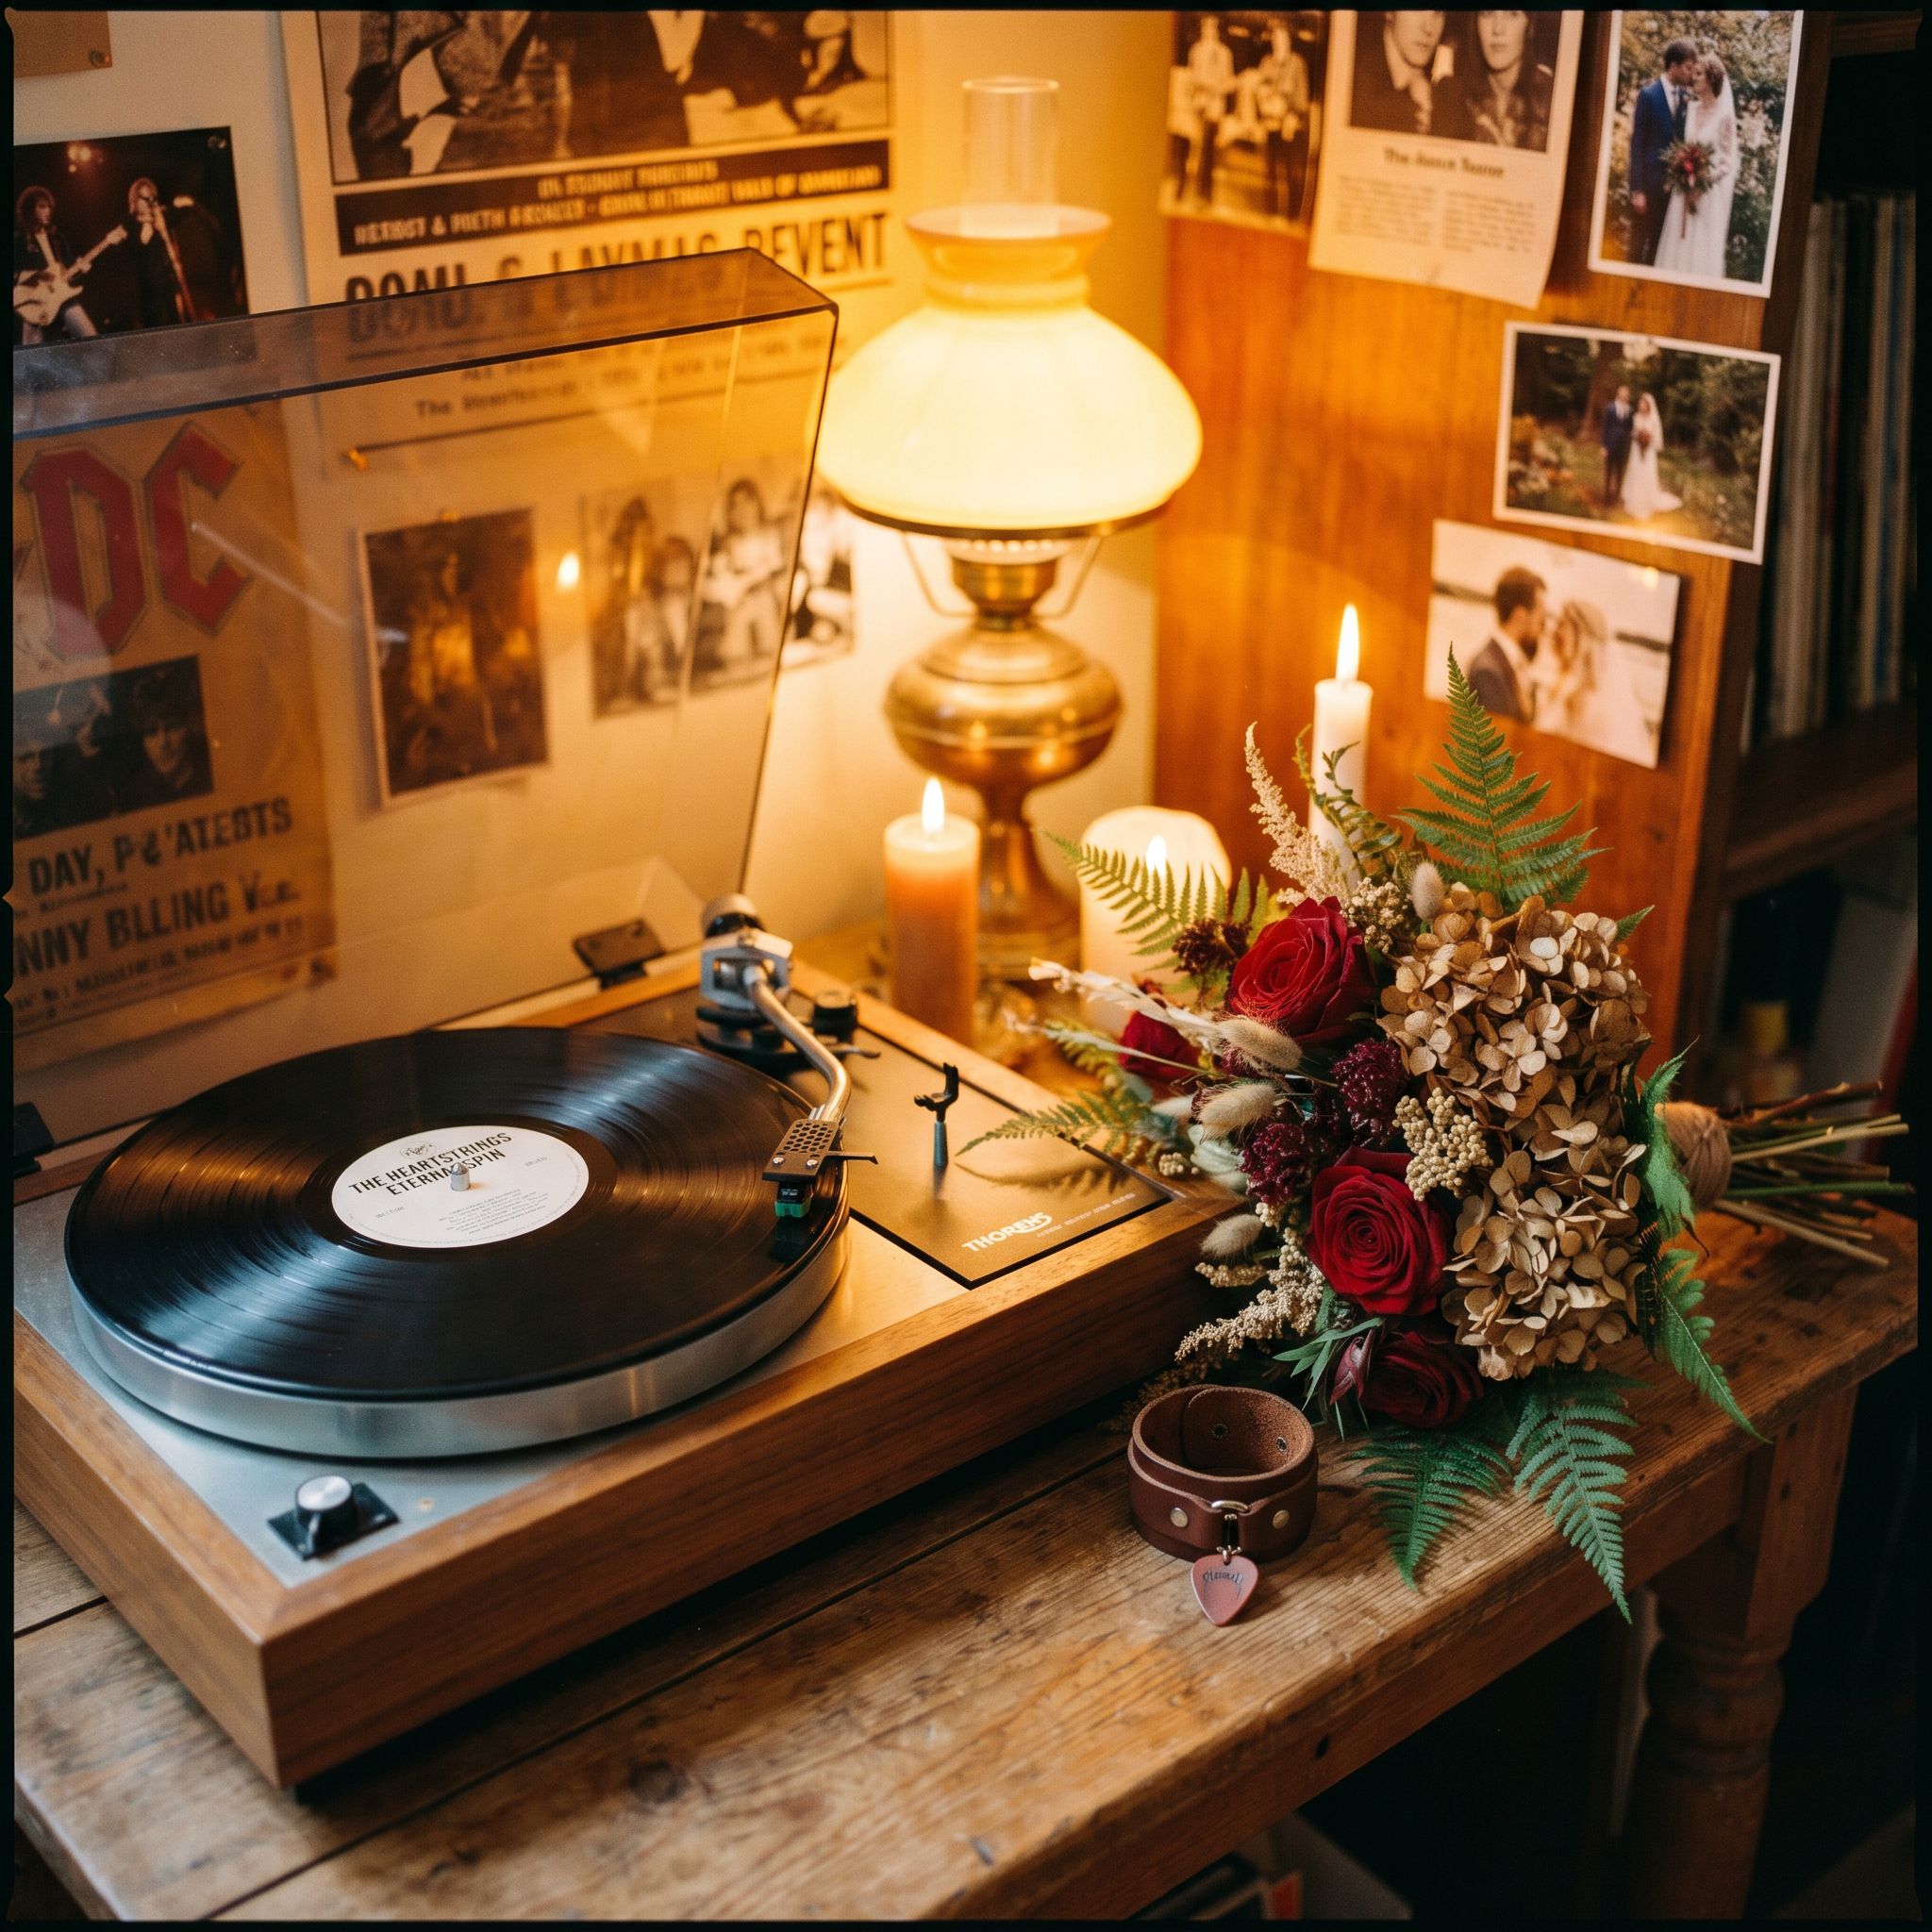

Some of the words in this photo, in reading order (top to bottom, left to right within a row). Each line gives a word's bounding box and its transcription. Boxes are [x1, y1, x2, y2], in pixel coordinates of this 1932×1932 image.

[348, 1175, 388, 1194] THE
[385, 1132, 512, 1182] HEARTSTRINGS
[386, 1164, 458, 1195] ETERNA
[468, 1149, 507, 1170] SPIN
